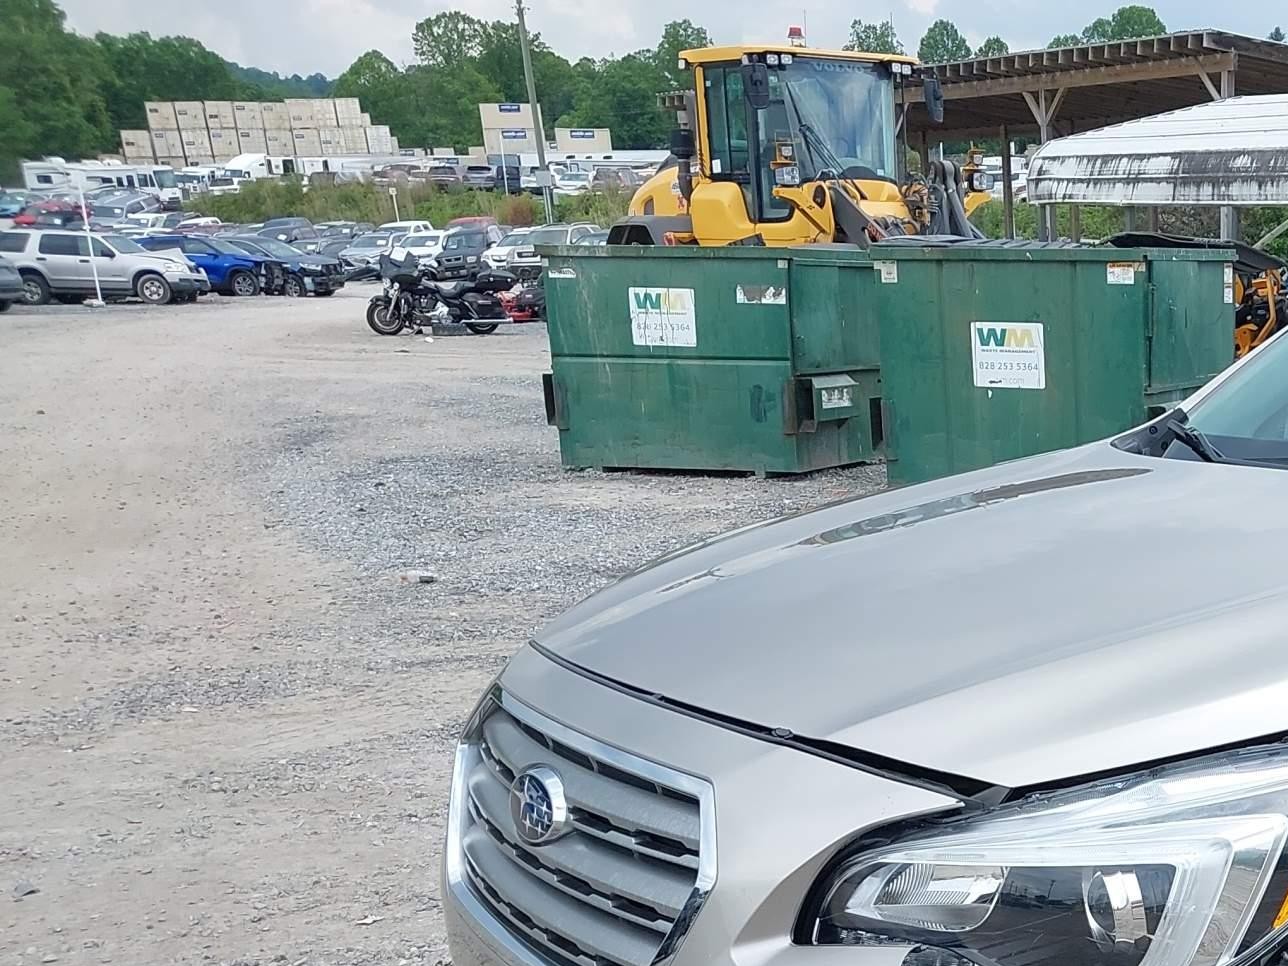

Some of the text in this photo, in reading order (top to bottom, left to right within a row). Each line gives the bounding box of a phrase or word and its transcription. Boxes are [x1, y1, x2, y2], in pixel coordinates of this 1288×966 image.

[812, 61, 865, 73] VOLVO
[976, 327, 1035, 347] WM
[978, 361, 1038, 371] 828 253 5364
